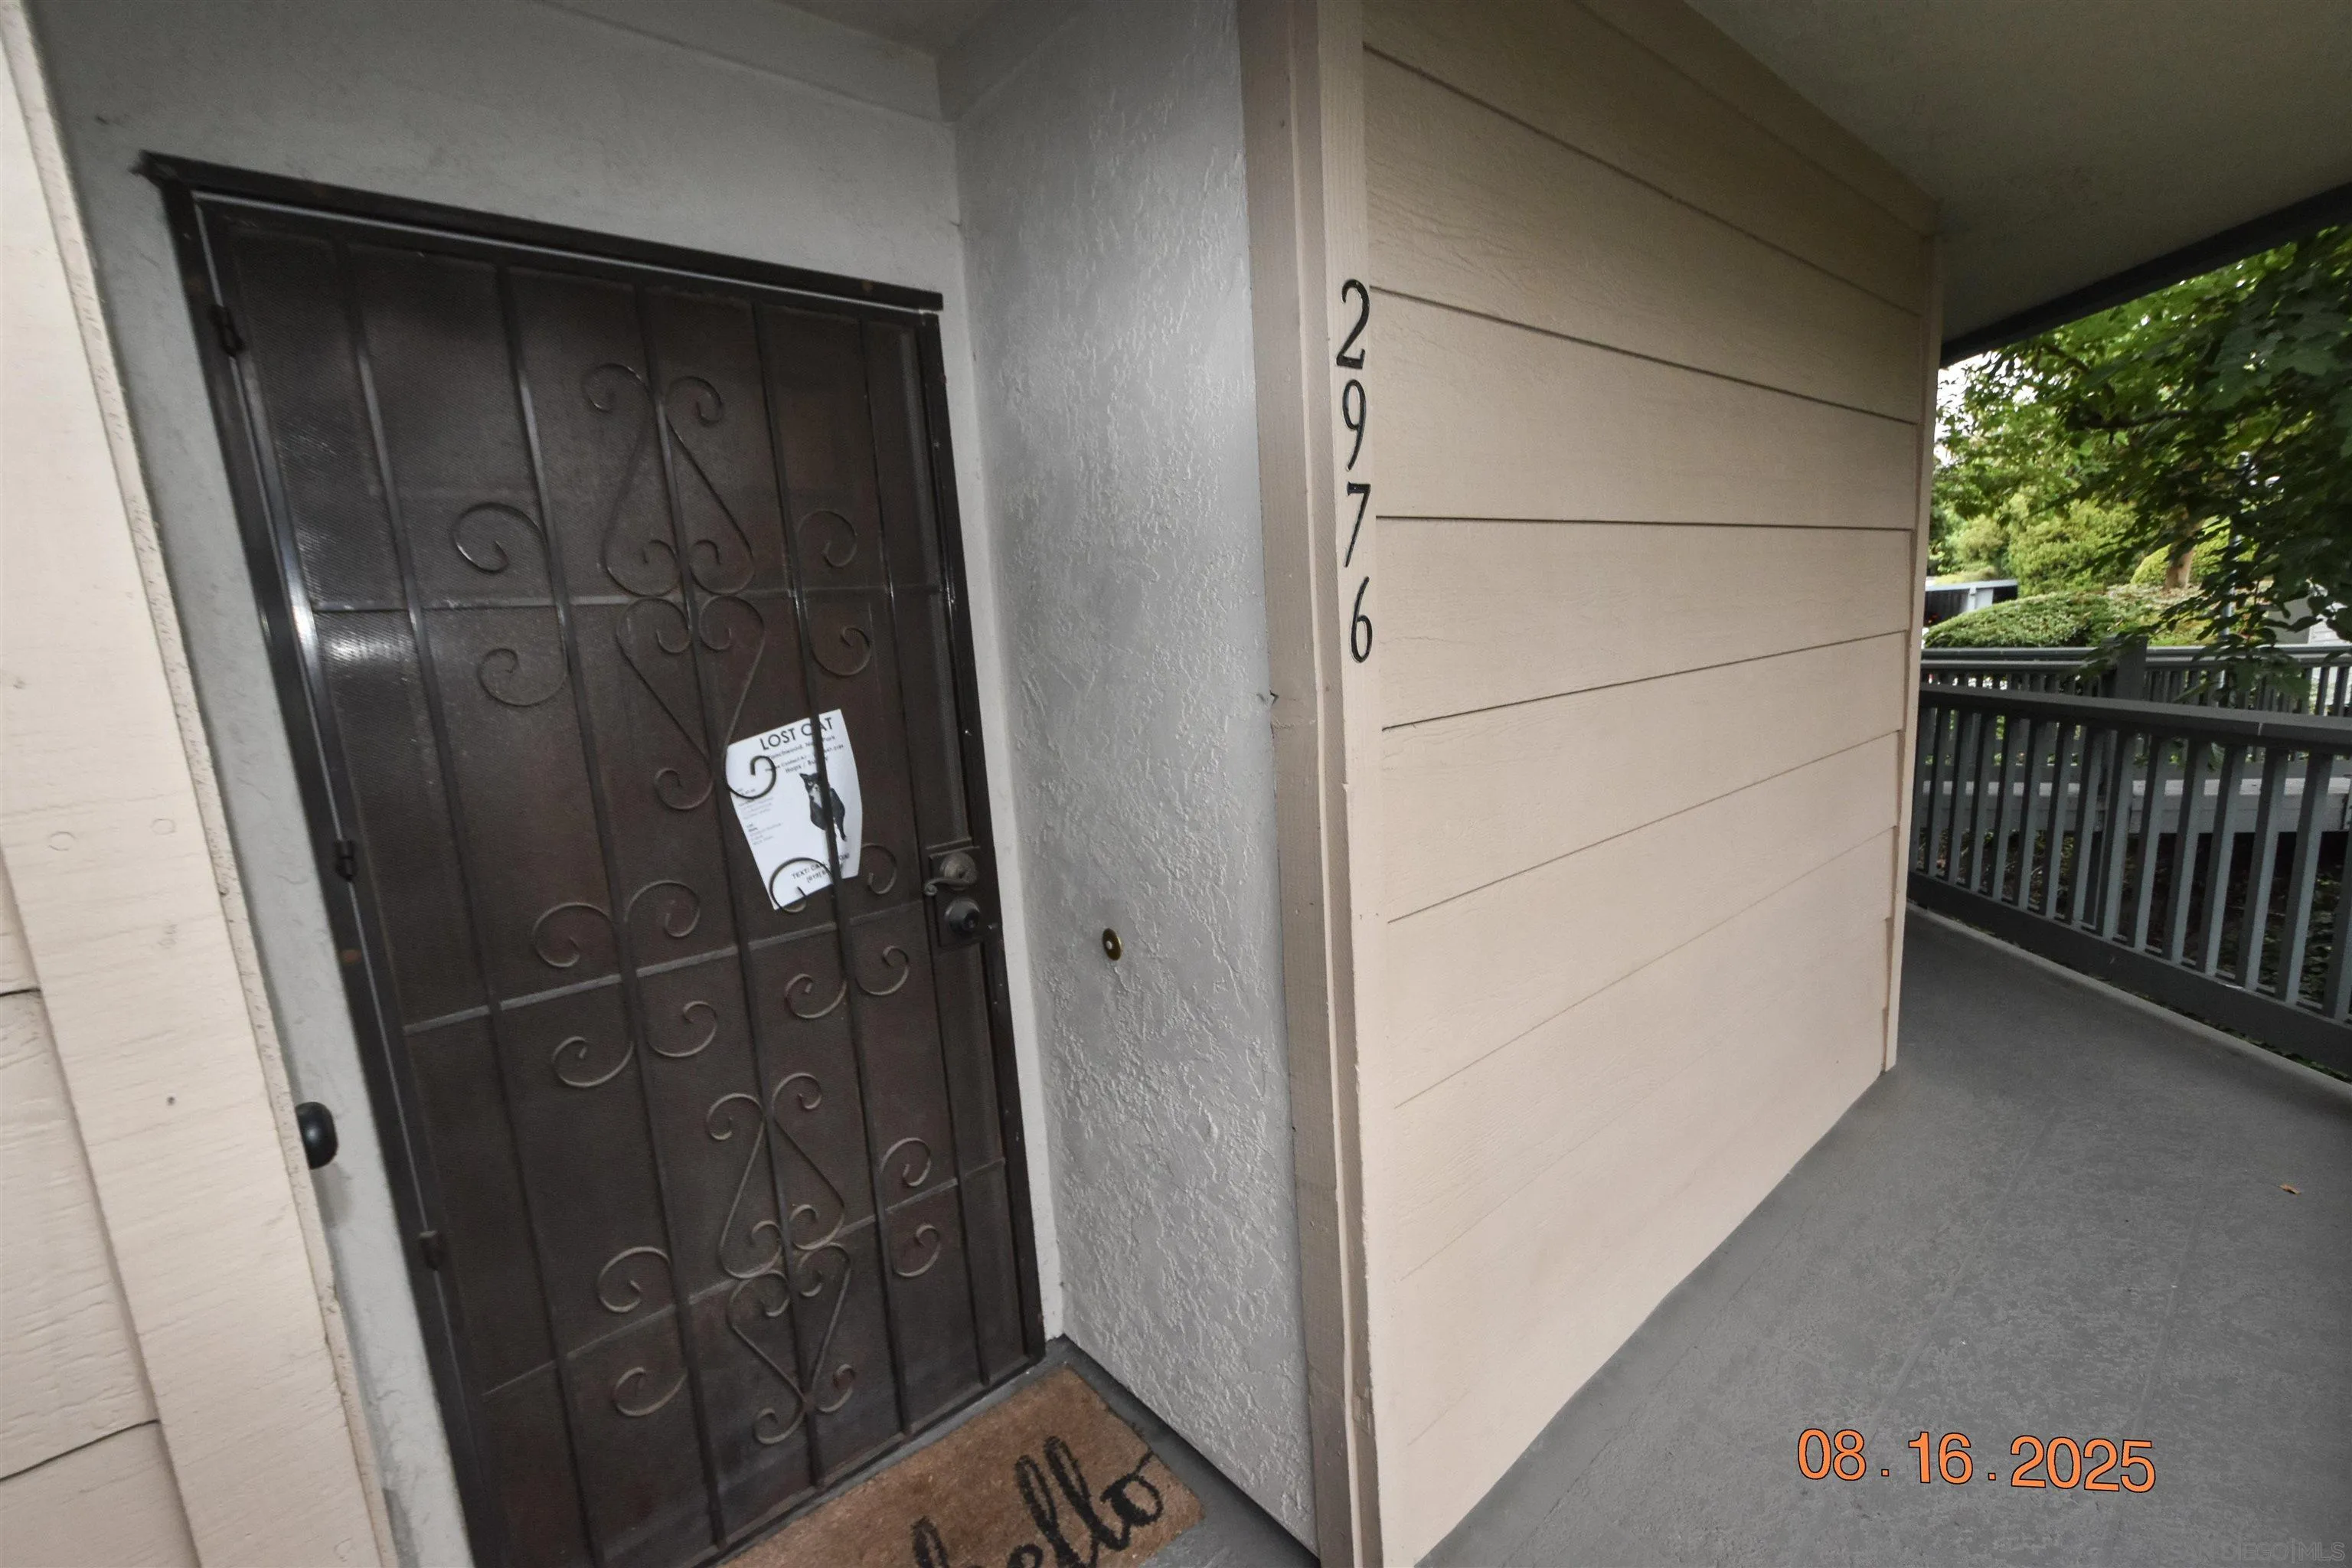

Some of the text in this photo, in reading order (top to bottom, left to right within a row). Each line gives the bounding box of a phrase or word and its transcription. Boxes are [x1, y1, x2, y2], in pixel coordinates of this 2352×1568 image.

[1336, 279, 1373, 663] 2976
[760, 727, 796, 750] LOST
[912, 1436, 1163, 1568] llo
